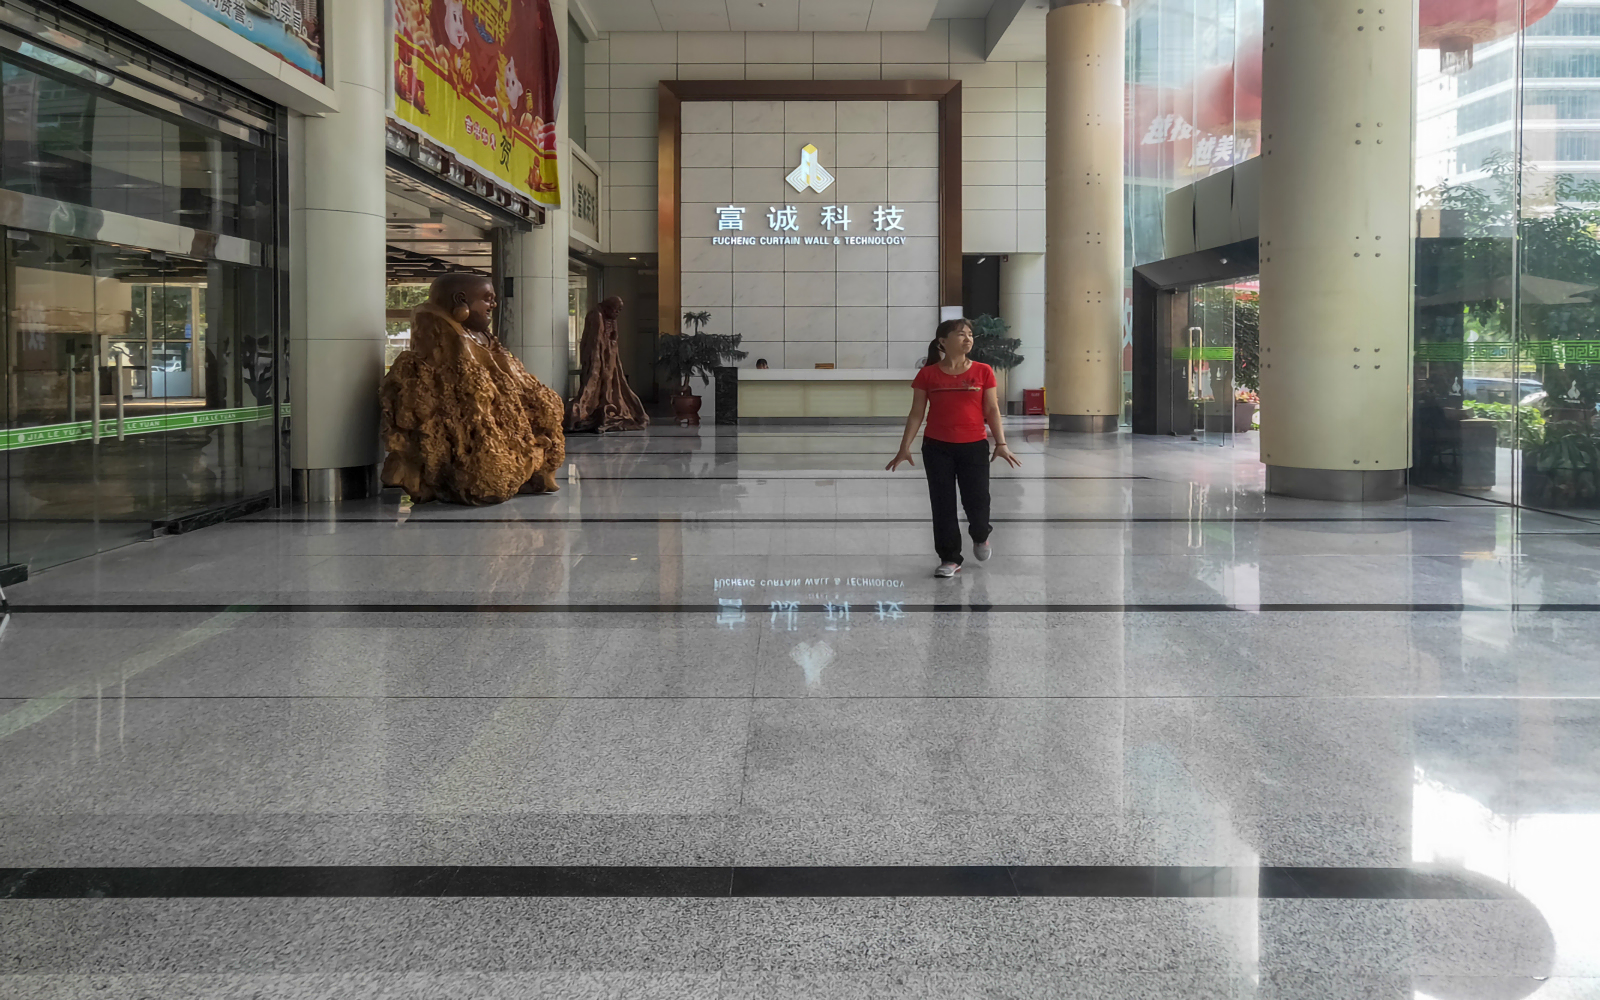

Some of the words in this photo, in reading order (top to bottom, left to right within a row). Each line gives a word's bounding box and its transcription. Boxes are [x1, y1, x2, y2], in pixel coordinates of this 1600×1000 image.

[715, 204, 905, 232] 富诚科技
[712, 236, 756, 246] FUCHENG
[759, 236, 800, 246] CURTAIN
[804, 236, 830, 246] WALL
[833, 236, 840, 246] &
[844, 236, 907, 246] TECHNOLOGY
[140, 420, 161, 428] YUAN
[27, 432, 45, 441] JIA
[47, 430, 59, 439] LE
[63, 428, 82, 437] YUA
